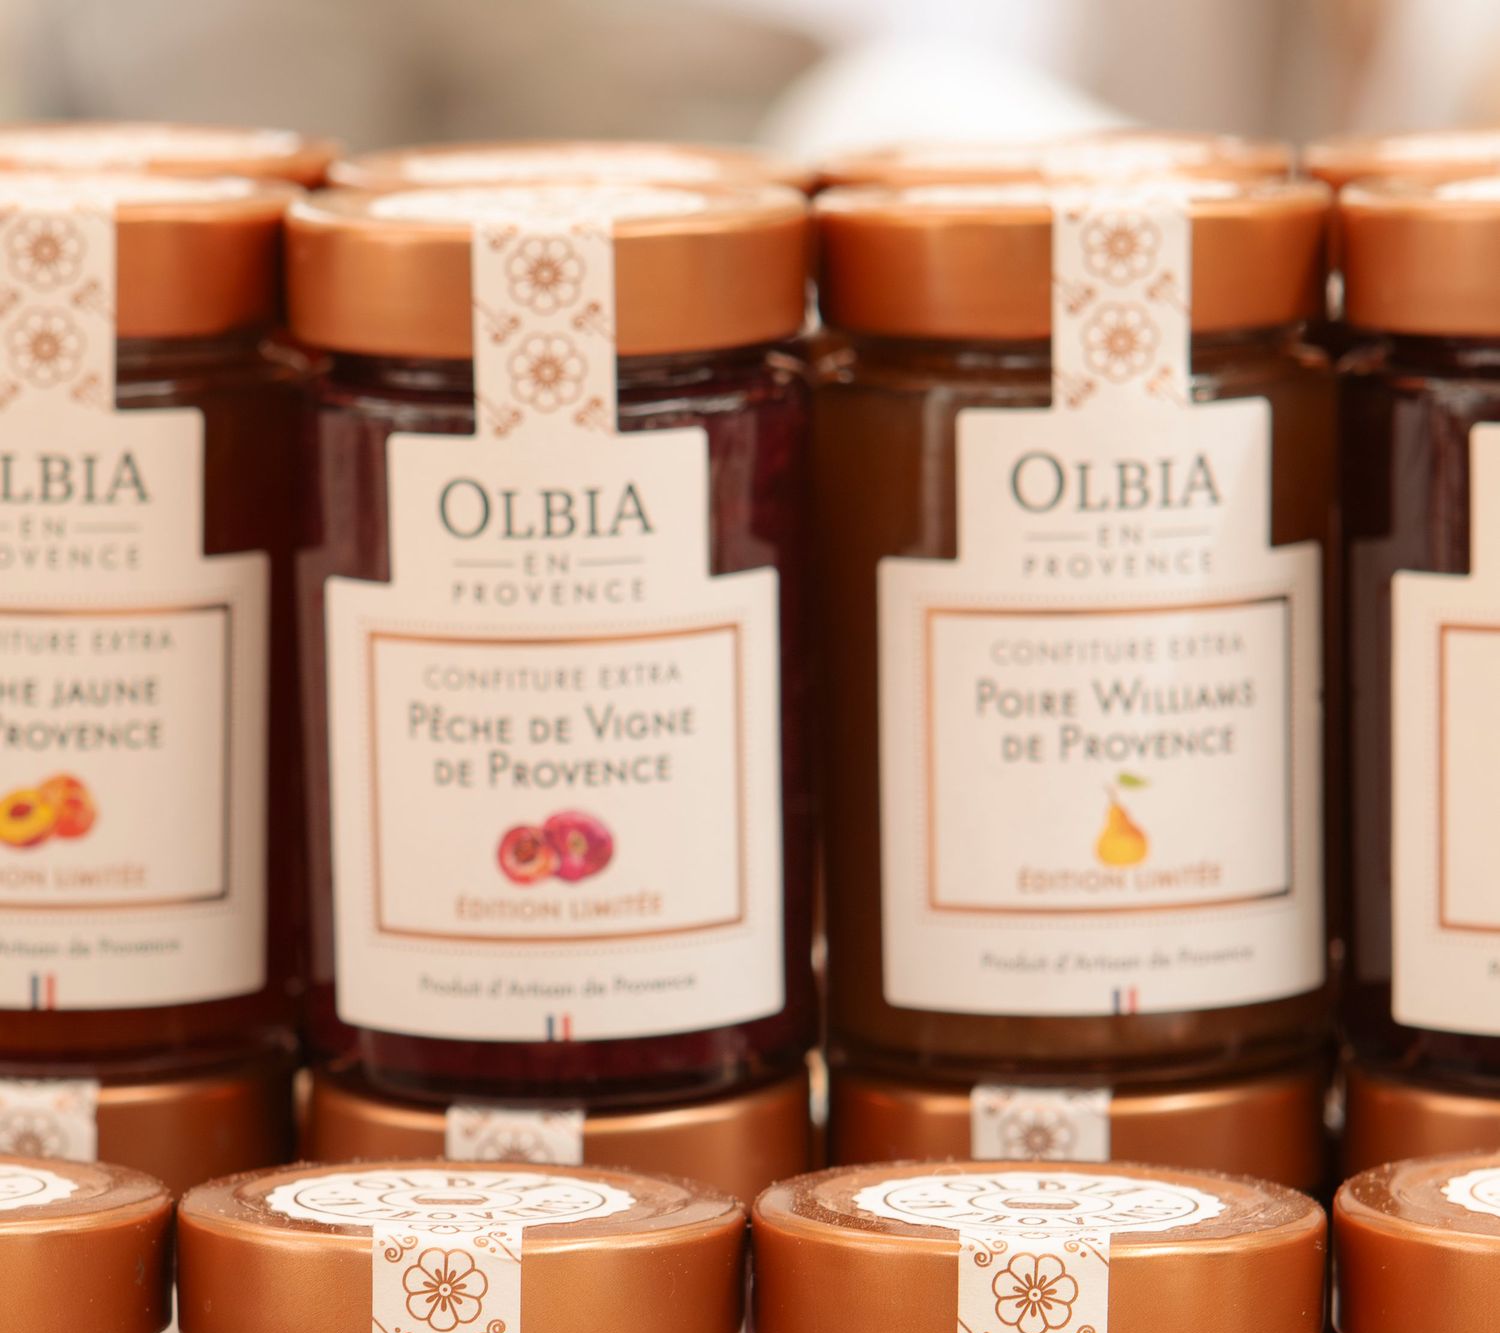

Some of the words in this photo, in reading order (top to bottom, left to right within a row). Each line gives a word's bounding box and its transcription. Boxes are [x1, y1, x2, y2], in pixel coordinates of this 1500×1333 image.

[0, 451, 149, 504] LBIA
[1009, 451, 1221, 513] OLBIA
[438, 478, 653, 539] OLBIA
[19, 520, 66, 539] EN
[1097, 525, 1142, 547] EN
[0, 544, 139, 570] OVENCE
[524, 553, 569, 575] EN
[1023, 551, 1211, 578] PROVENCE
[452, 578, 643, 605] PROVENCE
[991, 638, 1155, 665] CONFITURE
[1169, 635, 1245, 659] EXTRA
[424, 666, 584, 692] CONFITURE
[599, 663, 680, 687] EXTRA
[51, 679, 156, 708] JAUNE
[976, 678, 1075, 719] POIRE
[1092, 679, 1254, 714] WILLIAMS
[0, 716, 161, 750] ROVENCE
[409, 701, 510, 744] PÊCHE
[530, 717, 568, 744] DE
[584, 704, 691, 741] VIGNE
[1002, 734, 1041, 763] DE
[1059, 725, 1234, 761] PROVENCE
[434, 758, 471, 788] DE
[488, 750, 669, 788] PROVENCE
